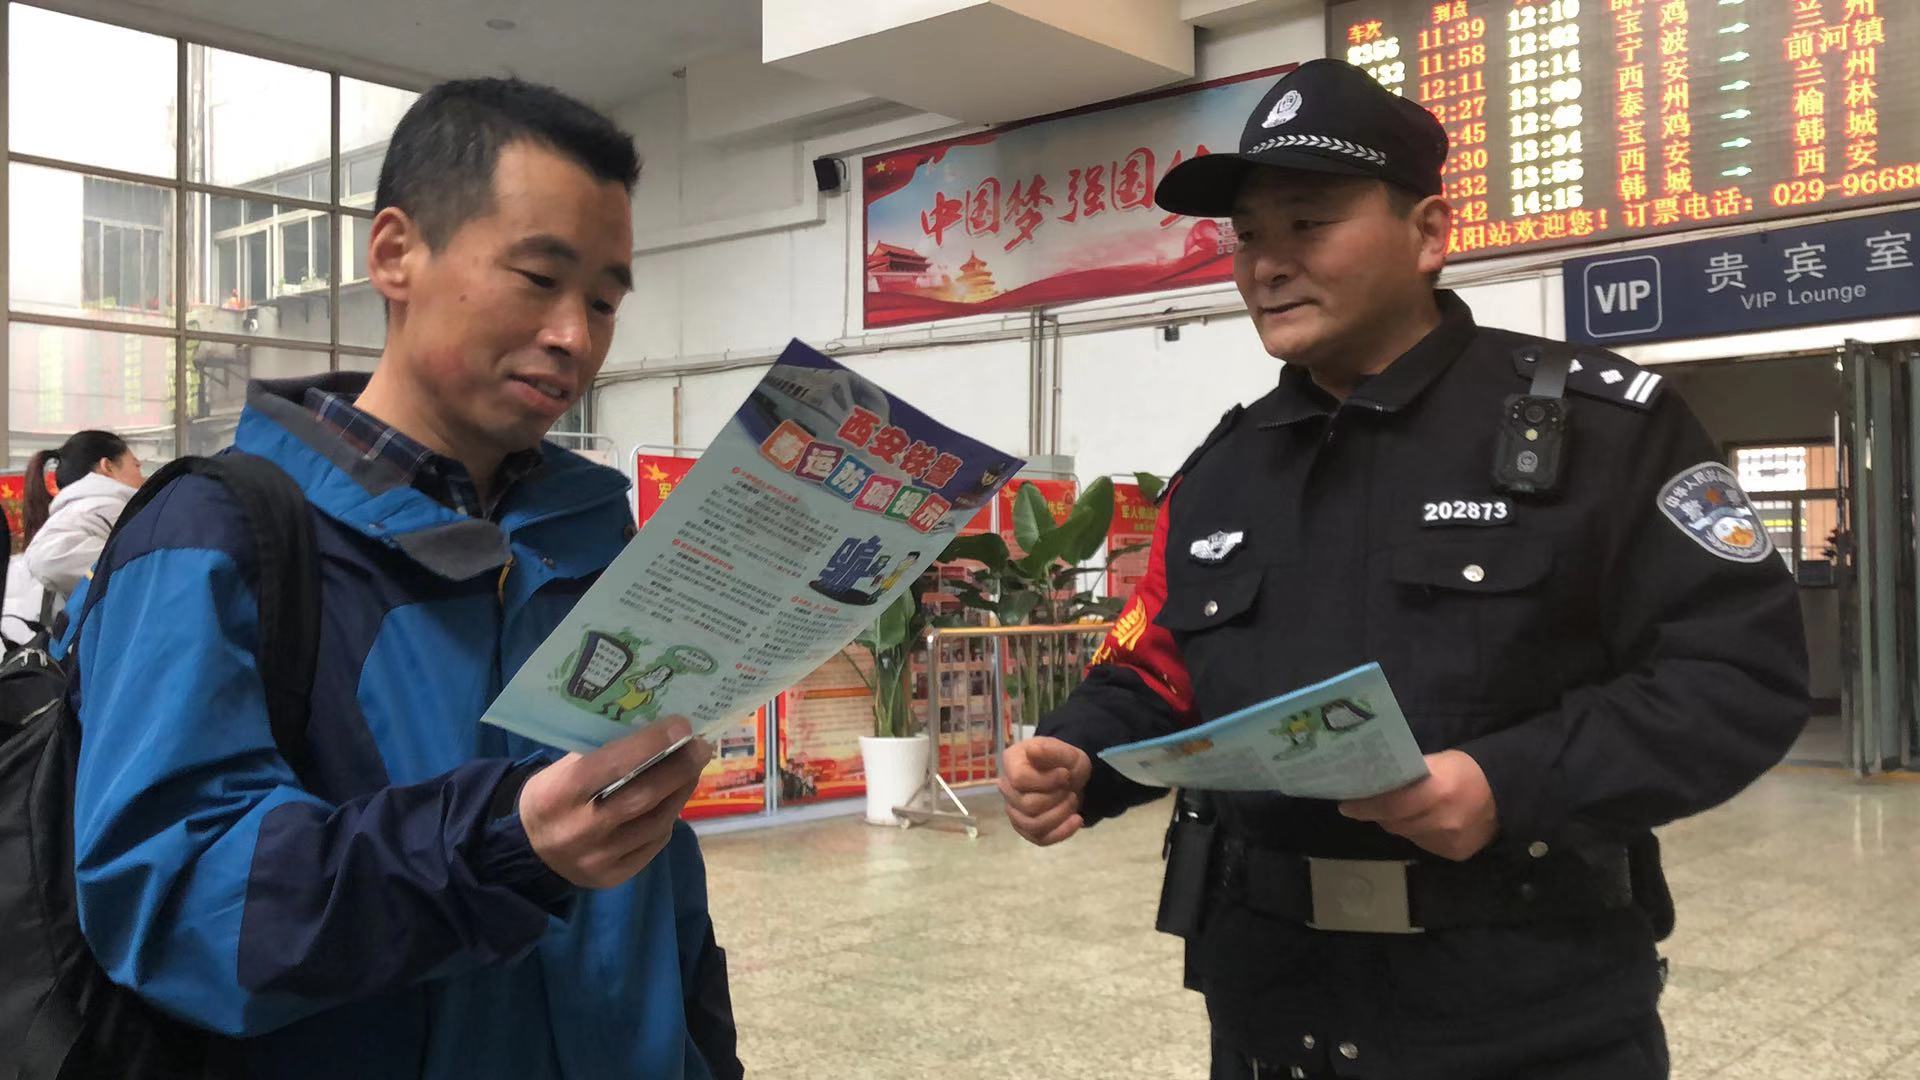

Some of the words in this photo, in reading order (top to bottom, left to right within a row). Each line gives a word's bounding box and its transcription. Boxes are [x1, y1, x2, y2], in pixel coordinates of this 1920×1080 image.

[1432, 1, 1469, 26] 到点
[1616, 0, 1689, 36] 宝鸡
[1793, 0, 1876, 30] 兰州
[1348, 21, 1383, 44] 车次
[1418, 18, 1487, 51] 11:39
[1617, 29, 1689, 63] 宁波
[1786, 16, 1886, 60] 前河镇
[1419, 44, 1487, 77] 11:58
[1509, 49, 1581, 84] 12:14
[1618, 57, 1689, 91] 西安
[1793, 47, 1877, 88] 兰州
[1419, 70, 1487, 102] 12:11
[1617, 85, 1690, 118] 泰州
[1794, 80, 1879, 116] 榆林
[1427, 96, 1487, 124] 2:27
[1448, 122, 1487, 148] :45
[1618, 111, 1692, 146] 宝鸡
[1794, 108, 1879, 146] 韩城
[1441, 148, 1488, 174] :30
[1619, 141, 1691, 174] 西安
[1797, 139, 1879, 177] 西安
[920, 144, 1212, 252] 中国梦强国
[1442, 174, 1488, 199] :32
[1512, 185, 1584, 216] 14:15
[1618, 168, 1693, 201] 韩城
[1451, 200, 1488, 225] :42
[1703, 229, 1914, 294] 贵宾室
[1594, 279, 1651, 315] VIP
[1741, 290, 1777, 310] VIP
[1788, 282, 1867, 306] Lounge
[1423, 500, 1509, 522] 202873
